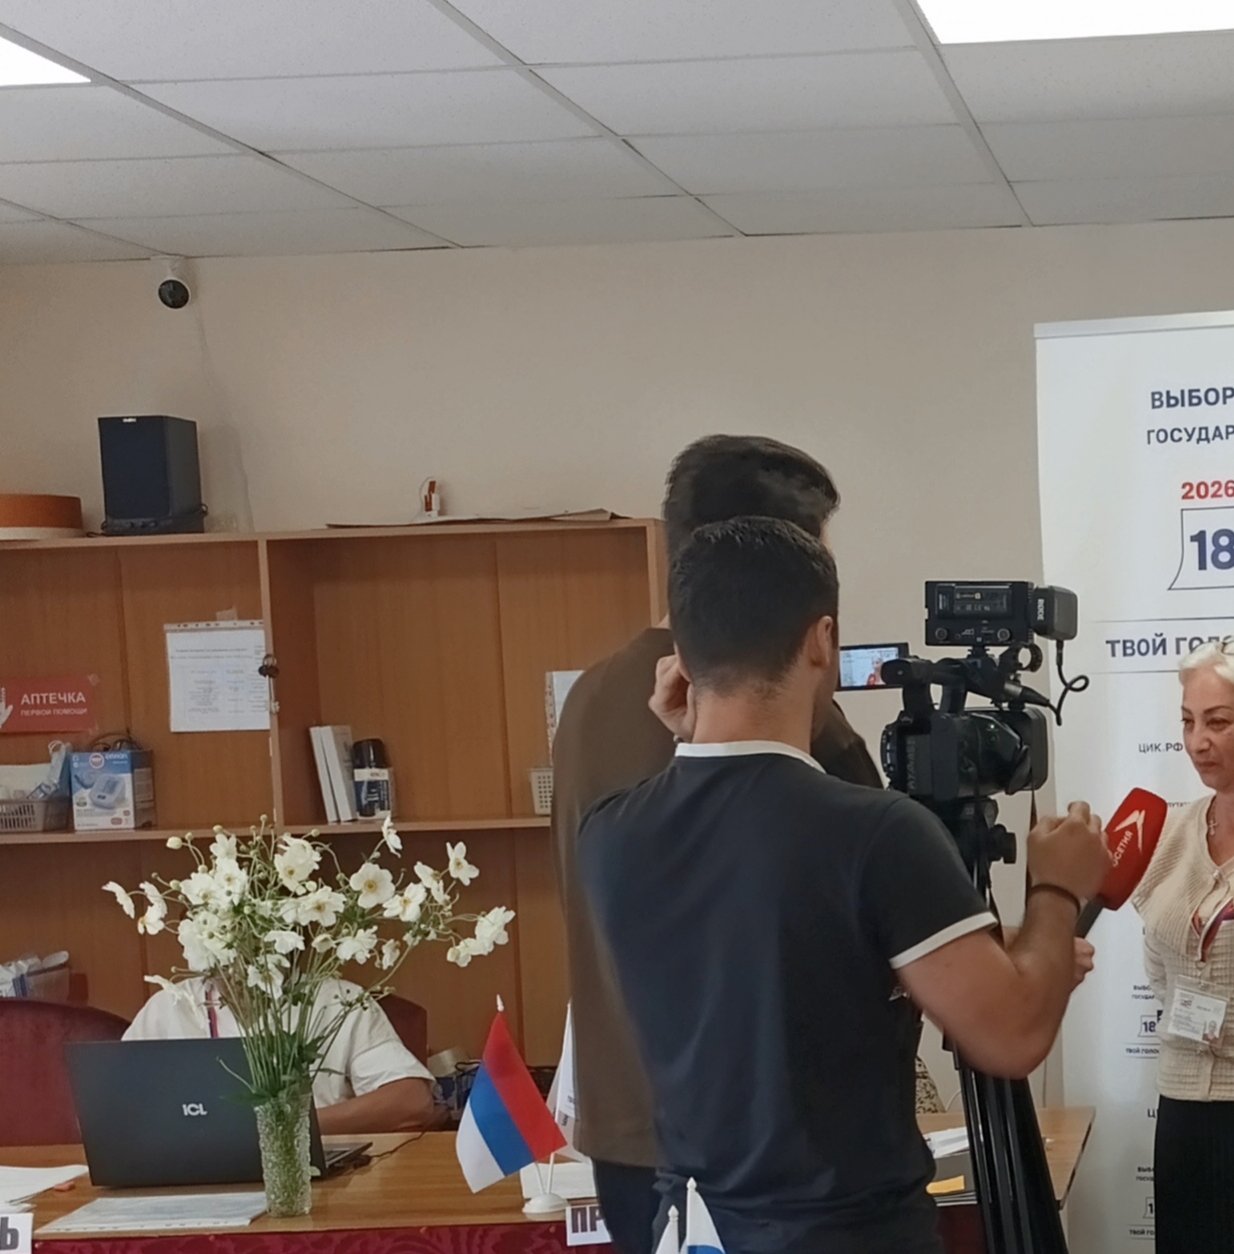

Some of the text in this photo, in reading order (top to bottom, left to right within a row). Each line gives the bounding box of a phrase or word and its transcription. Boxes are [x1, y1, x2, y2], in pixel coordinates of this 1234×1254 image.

[1106, 633, 1168, 658] ТВОЙ
[21, 692, 86, 706] АПТЕЧКА
[21, 707, 88, 717] ПЕРВОЙ ПОМОЩИ
[1139, 742, 1183, 753] ЦИК.РФ
[1143, 1021, 1156, 1032] 18
[182, 1103, 207, 1117] ICL
